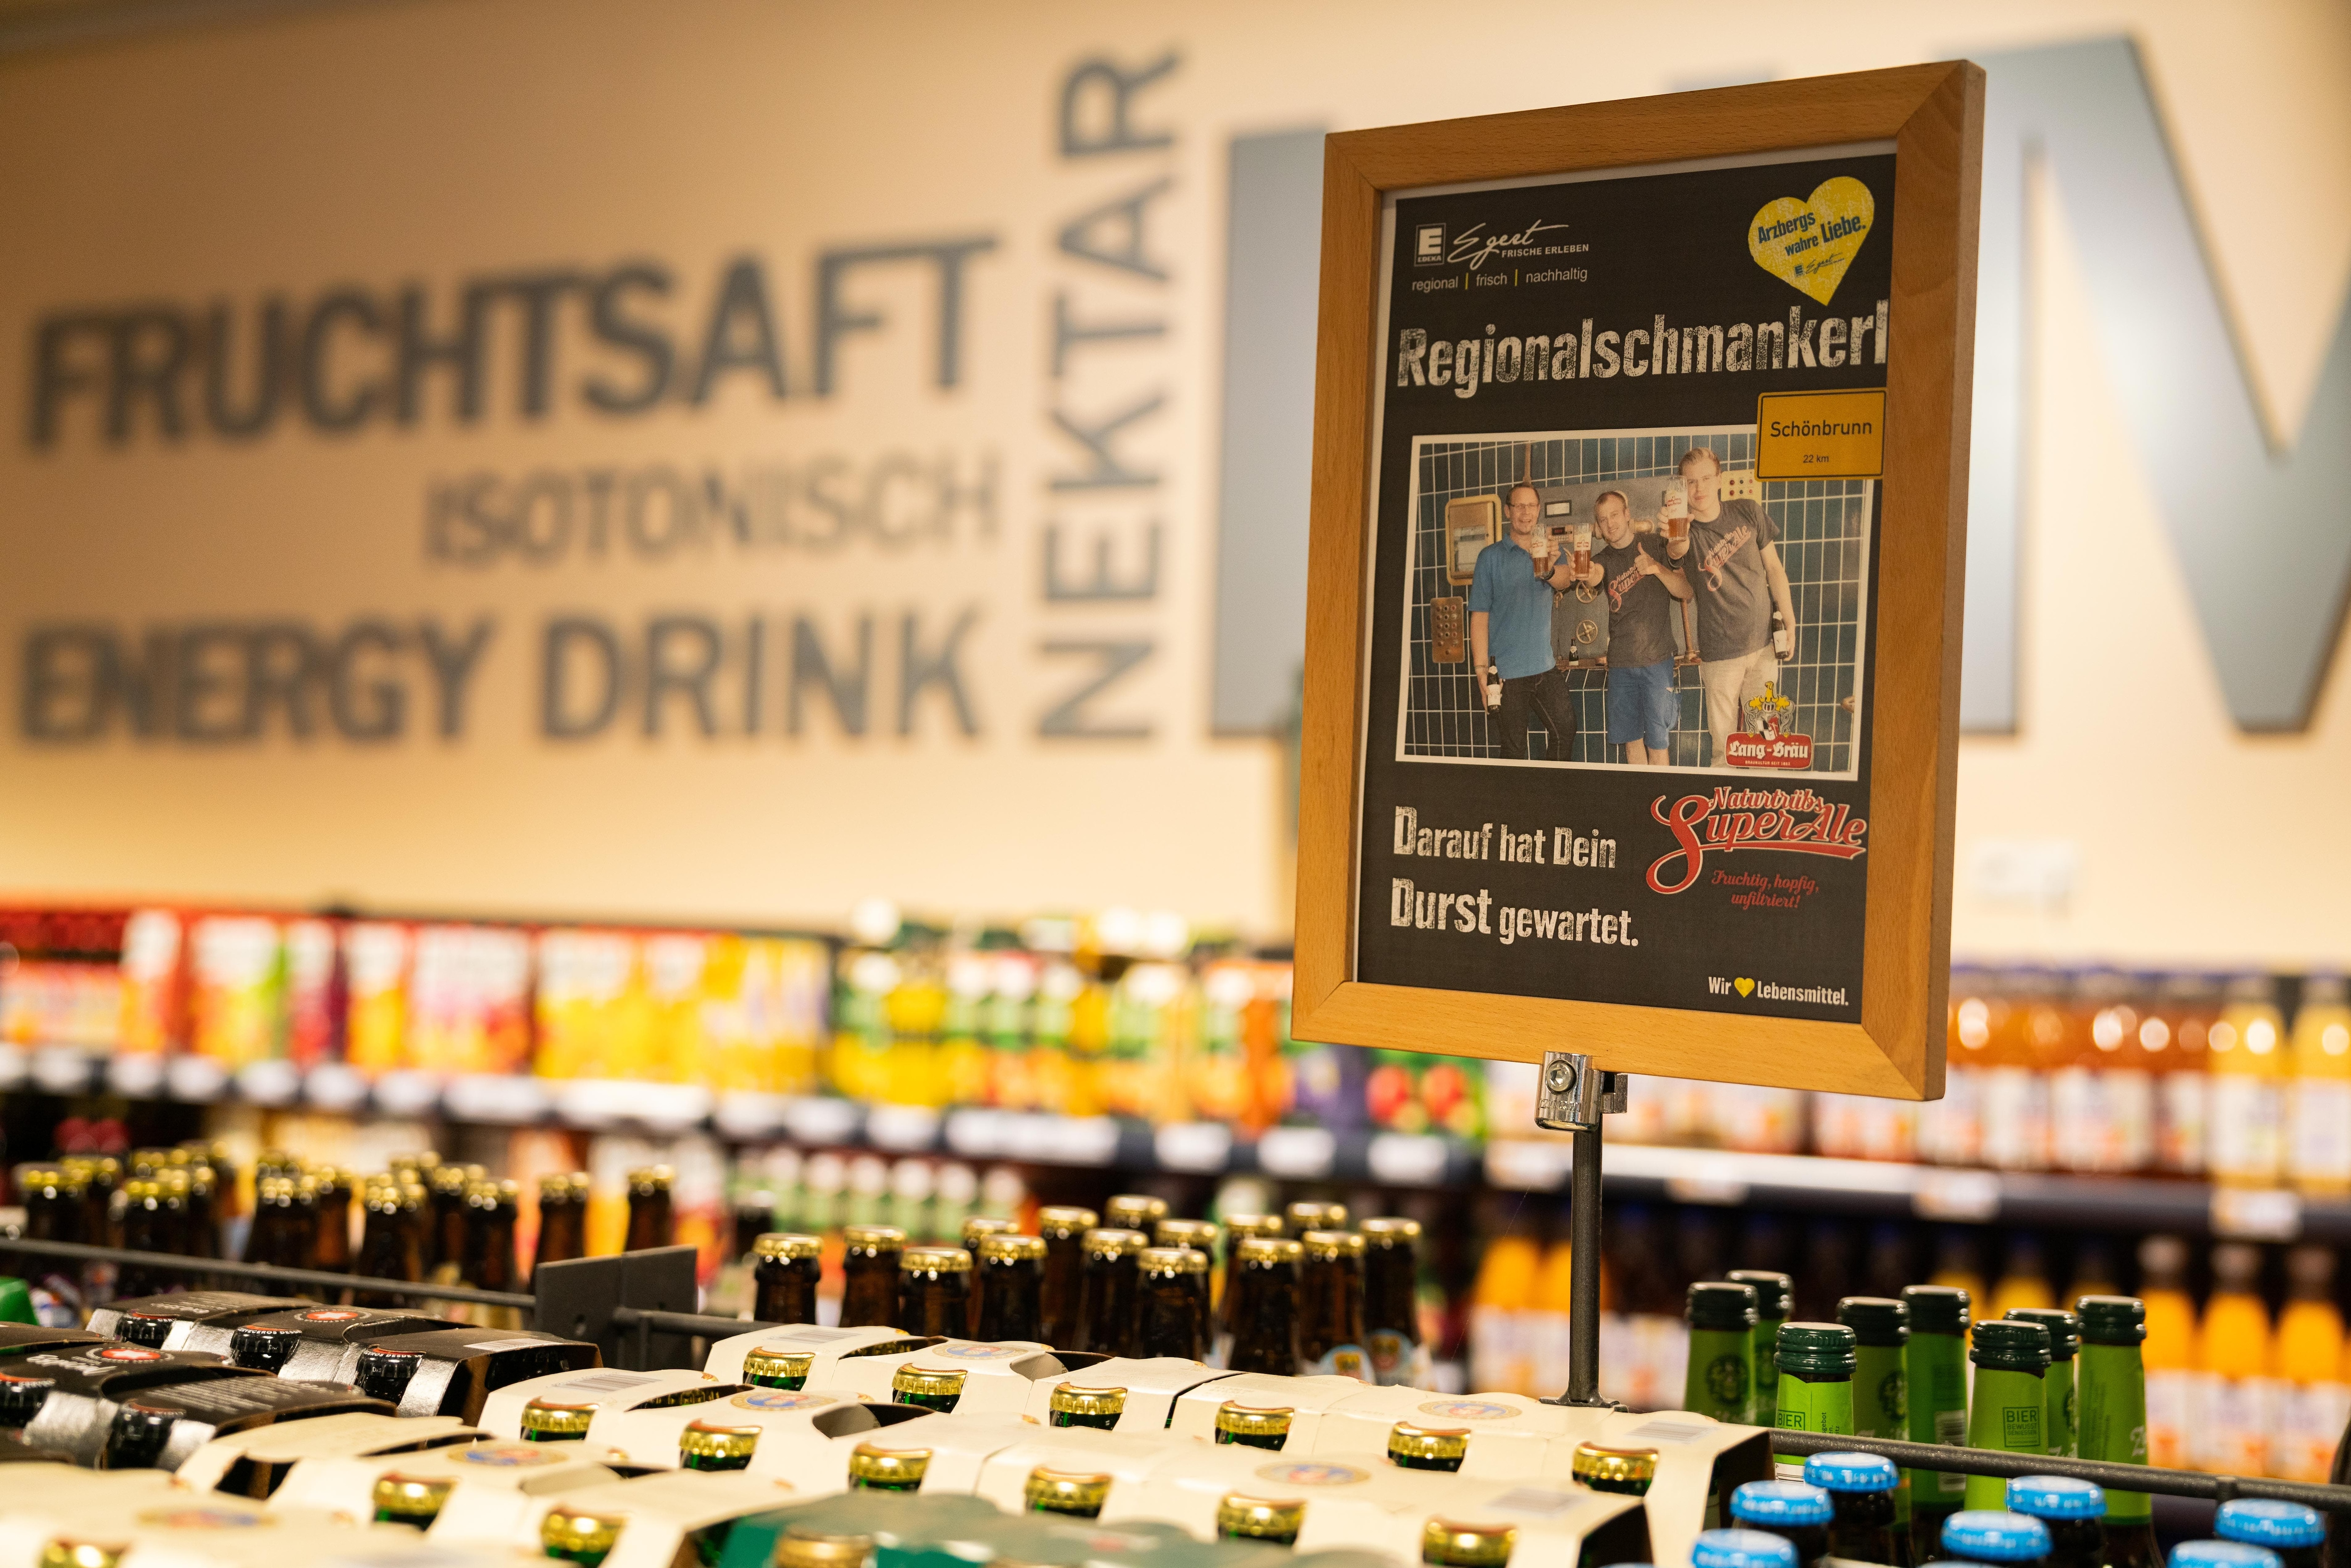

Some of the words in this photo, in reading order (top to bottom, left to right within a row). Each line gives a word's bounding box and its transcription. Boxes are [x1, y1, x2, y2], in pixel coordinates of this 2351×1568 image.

[1758, 212, 1815, 244] Arzbergs
[1785, 235, 1819, 256] wahre
[1821, 216, 1866, 243] Liebe.
[1447, 219, 1569, 270] Egert
[1501, 247, 1542, 258] FRISCHE
[1545, 244, 1589, 255] ERLEBEN
[1412, 276, 1458, 293] regional
[1476, 273, 1507, 287] frisch
[1526, 267, 1588, 283] nachhaltig
[24, 230, 1002, 451] FRUCHTSAFT
[1397, 299, 1888, 399] Regionalschmankerl
[1037, 45, 1184, 741] NEKTAR
[1770, 419, 1872, 437] Schönbrunn
[1816, 454, 1829, 463] km
[423, 451, 1002, 571] ISOTONISCH
[16, 616, 494, 747] ENERGY
[538, 604, 987, 743] DRINK
[1709, 786, 1825, 813] Naturtrübs
[1394, 806, 1493, 859] Darauf
[1500, 823, 1546, 864] hat
[1553, 827, 1616, 868] Dein
[1712, 870, 1772, 889] Fruchtig,
[1774, 873, 1820, 894] hopfig,
[1391, 877, 1492, 934] Durst
[1499, 906, 1639, 946] gewartet.
[1731, 890, 1800, 909] unfiltriert!
[1708, 977, 1731, 994] Wir
[1757, 980, 1849, 1006] Lebensmittel.
[1778, 1413, 1802, 1428] BIER
[2006, 1410, 2036, 1422] BIER
